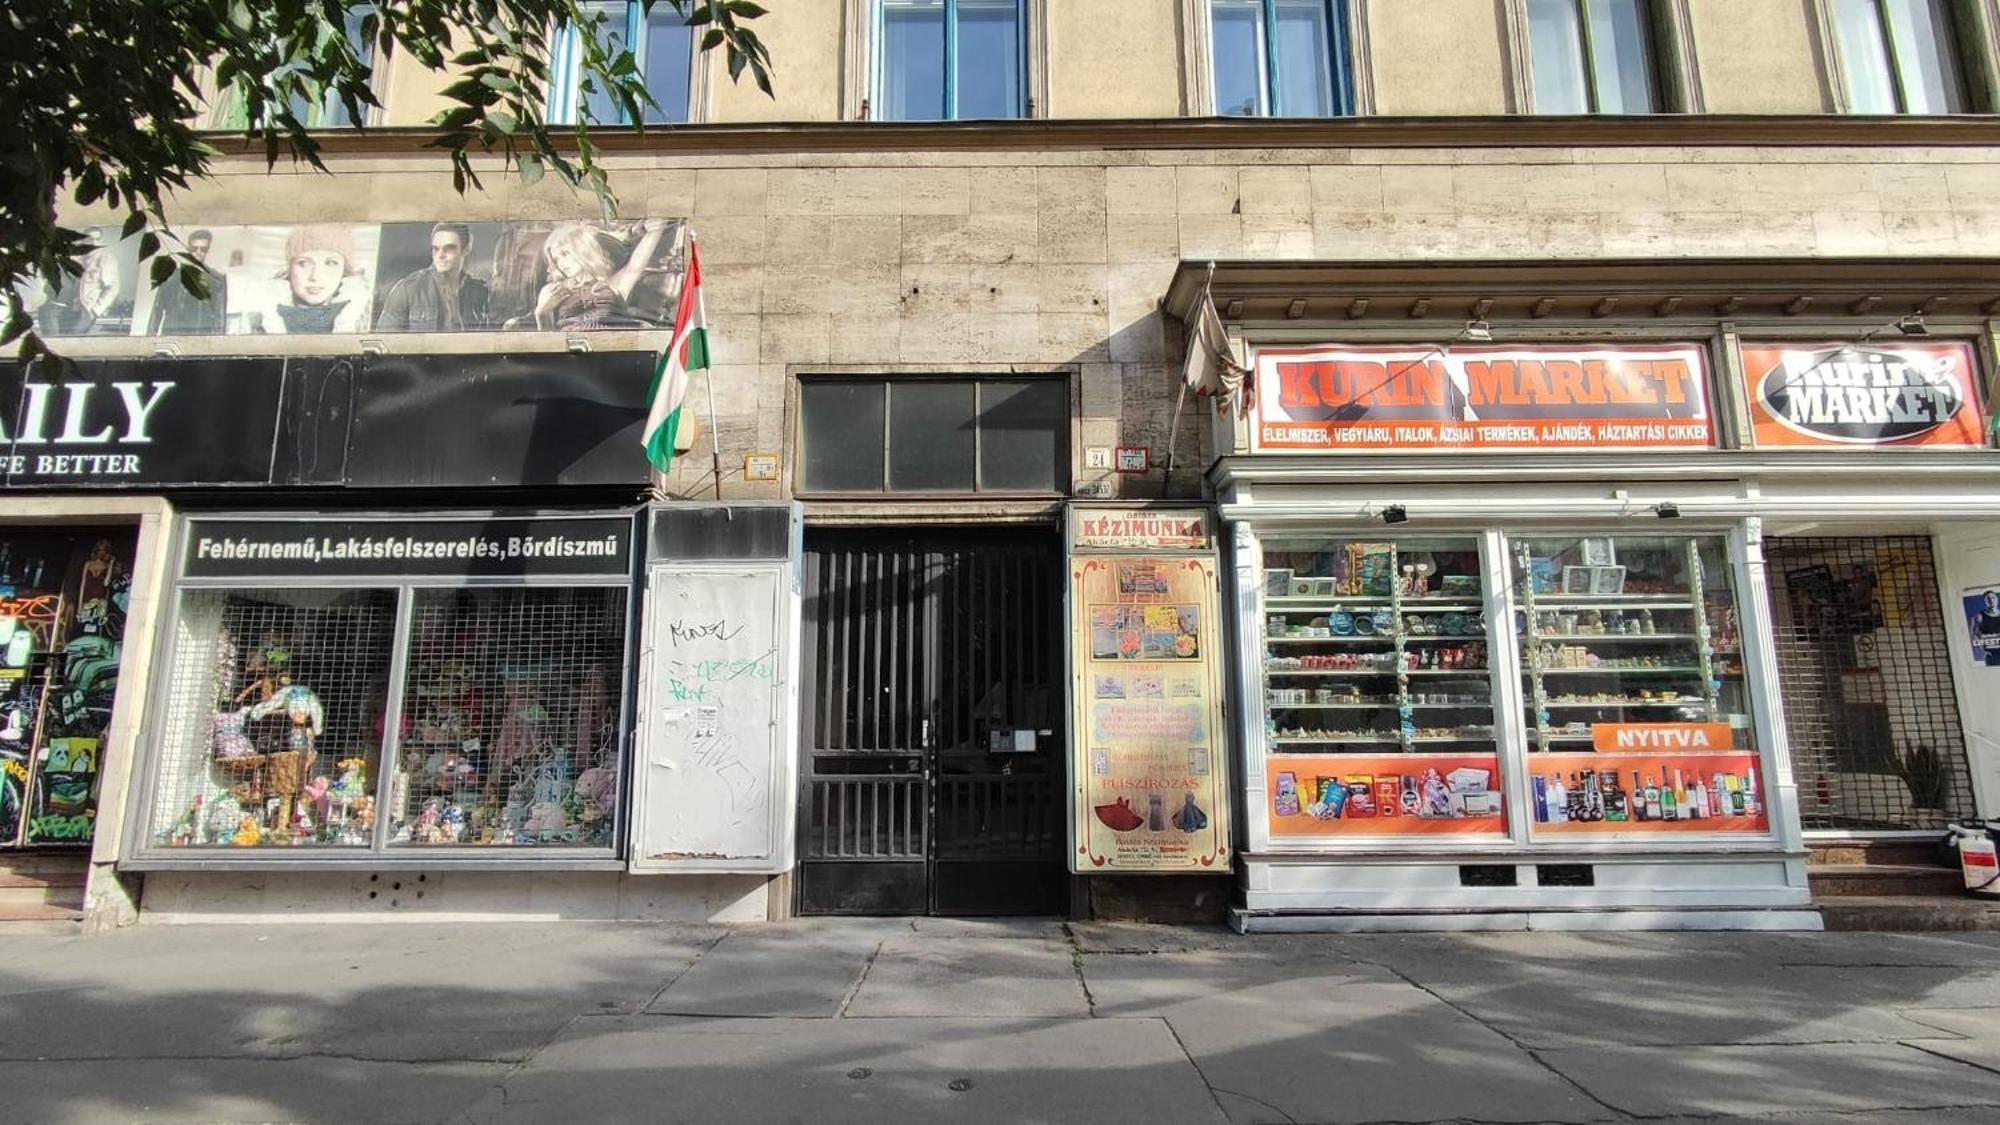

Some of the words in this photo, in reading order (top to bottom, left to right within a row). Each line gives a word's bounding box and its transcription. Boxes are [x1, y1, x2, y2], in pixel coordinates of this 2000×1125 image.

[1277, 360, 1449, 407] KURIN
[1463, 358, 1689, 405] MARKET
[0, 381, 176, 443] ILY
[1787, 385, 1953, 424] MARKET
[1262, 426, 1332, 446] ÉLELMISZER,
[1334, 426, 1393, 446] VEGYIÁRU,
[1395, 426, 1437, 445] ITALOK,
[1477, 425, 1540, 444] TERMÉKEK,
[1541, 423, 1596, 443] AJÁNDÉK,
[1598, 422, 1666, 441] HÁZTARTÁSI
[1667, 424, 1709, 440] CIKKEK
[34, 454, 142, 475] BETTER
[1083, 516, 1204, 537] KÉZIMUNKA
[1616, 729, 1710, 748] NYITVA
